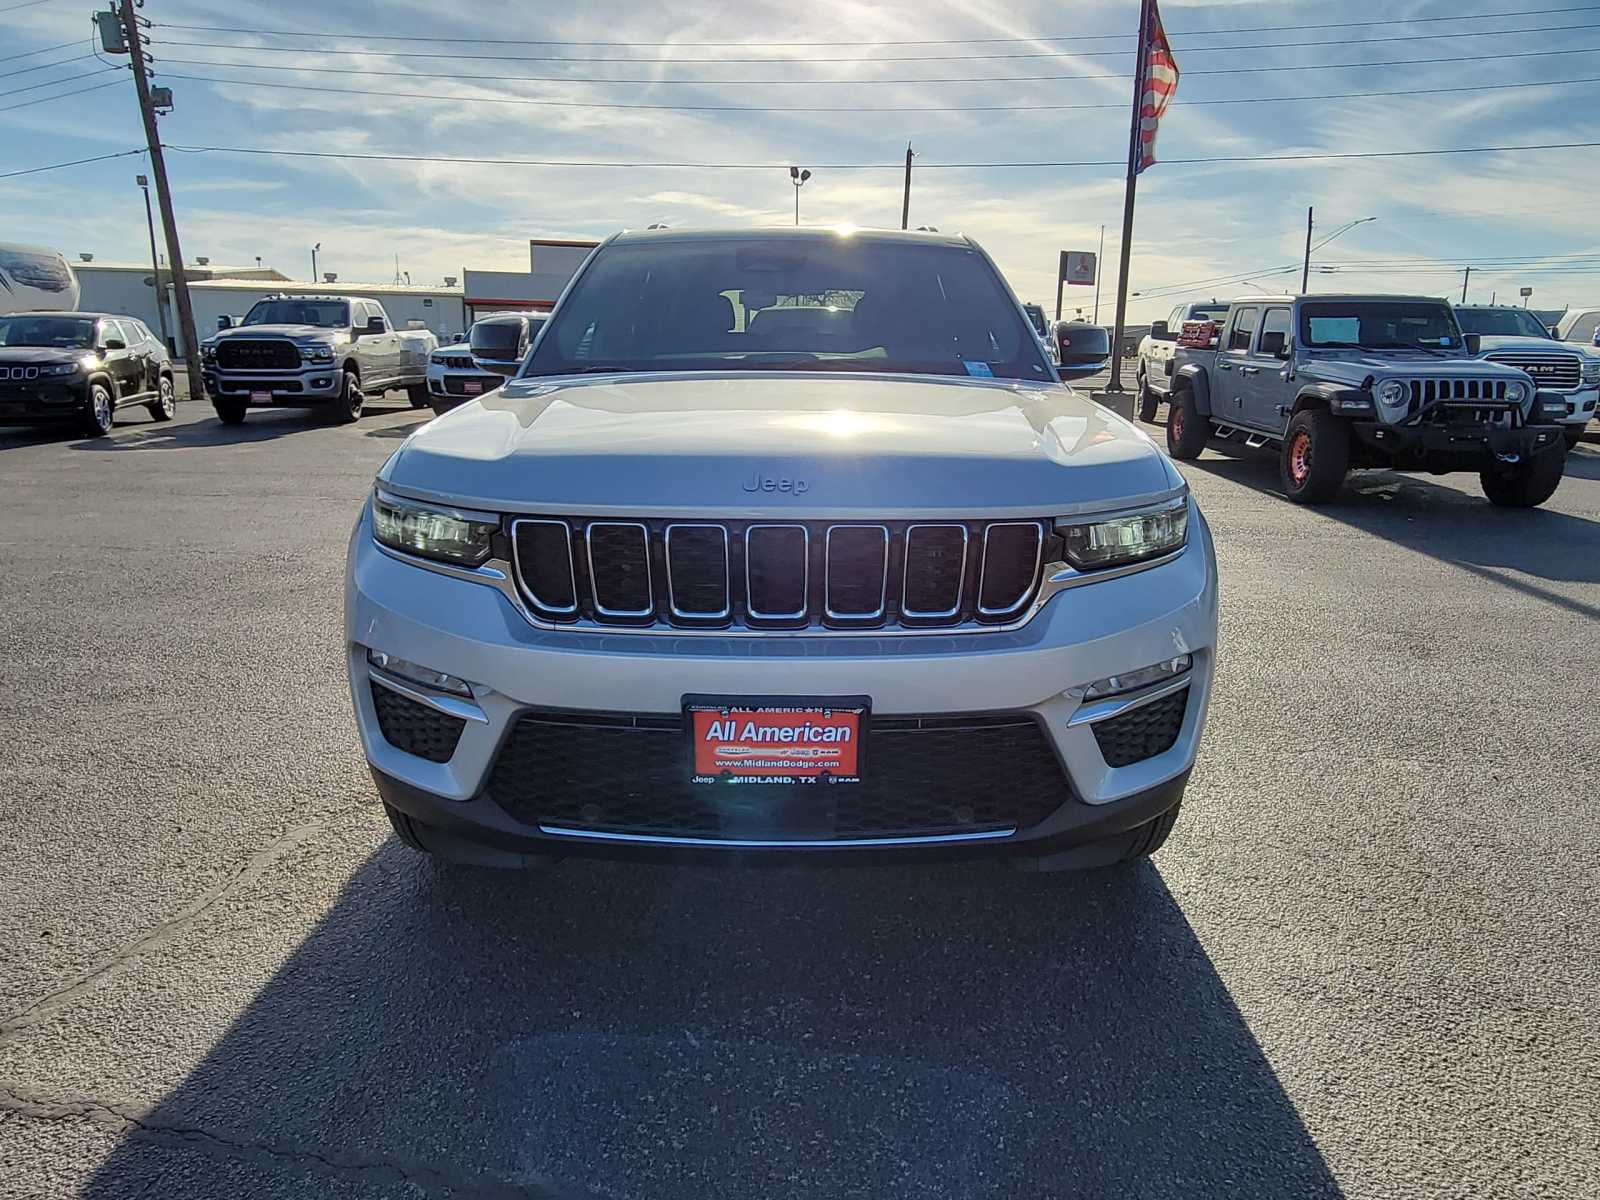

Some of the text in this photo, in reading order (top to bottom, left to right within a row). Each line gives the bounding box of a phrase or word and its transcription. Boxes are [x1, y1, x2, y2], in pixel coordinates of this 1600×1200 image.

[742, 471, 809, 496] Jeep
[705, 720, 851, 743] All American
[714, 759, 840, 768] www.MidlandDodge.com
[799, 776, 816, 784] TX
